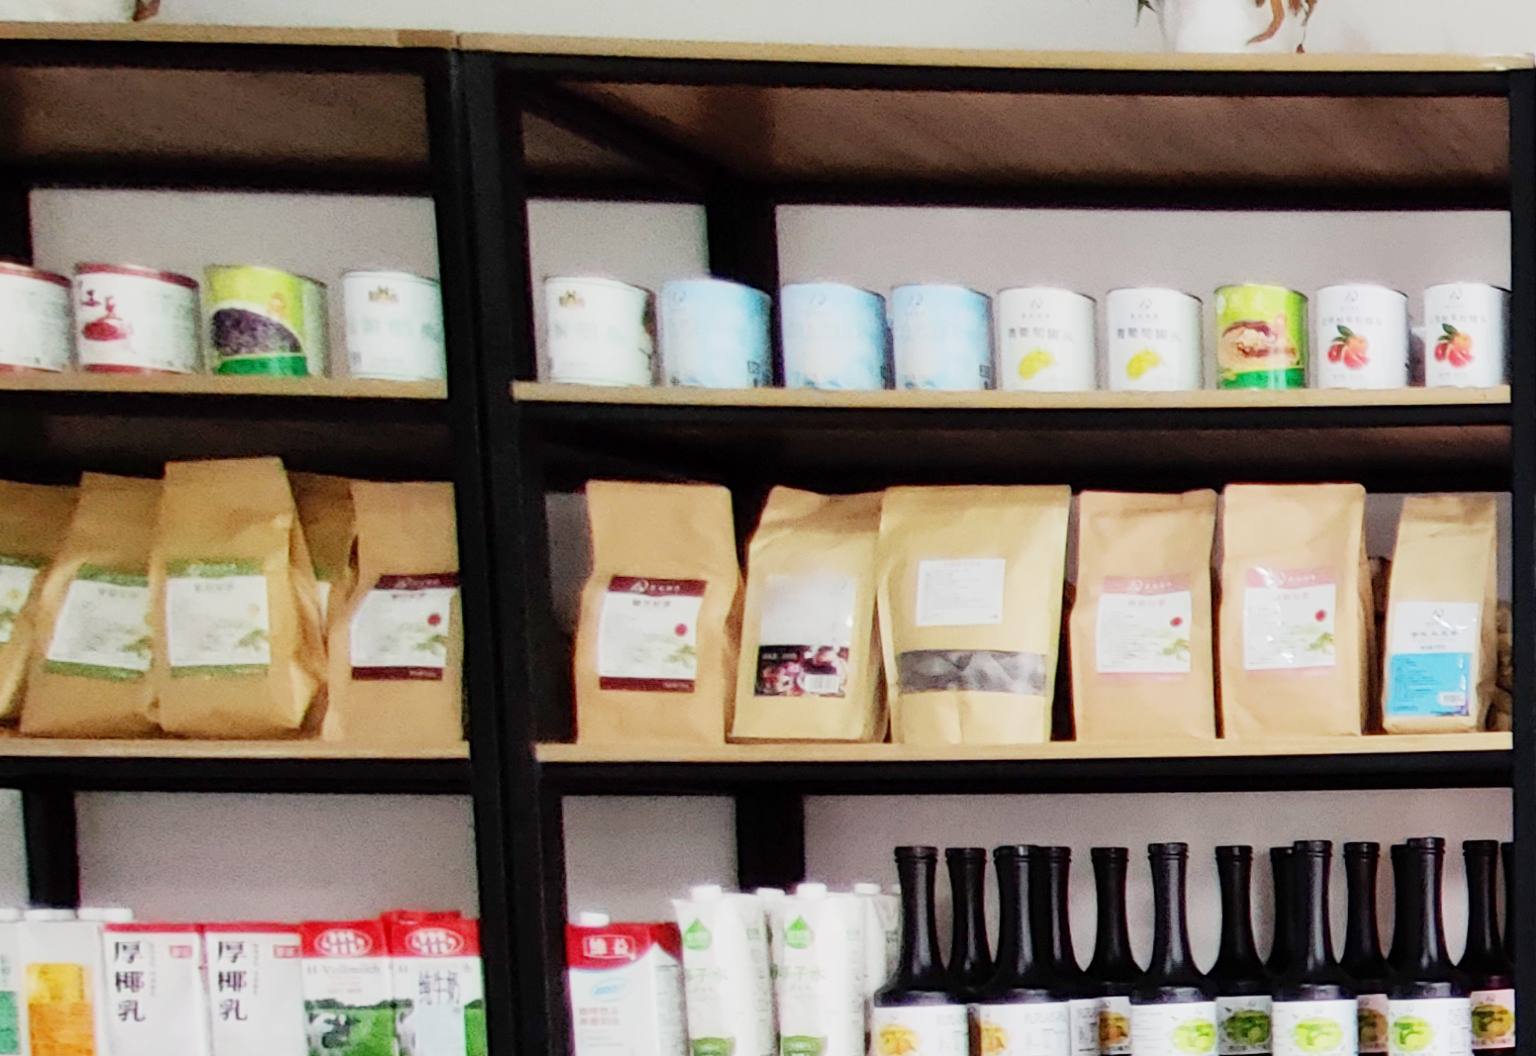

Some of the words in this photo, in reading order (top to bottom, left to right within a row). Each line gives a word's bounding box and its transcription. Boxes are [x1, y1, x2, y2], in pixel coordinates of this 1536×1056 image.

[114, 941, 146, 1022] 厚椰乳
[217, 941, 248, 1021] 厚椰乳
